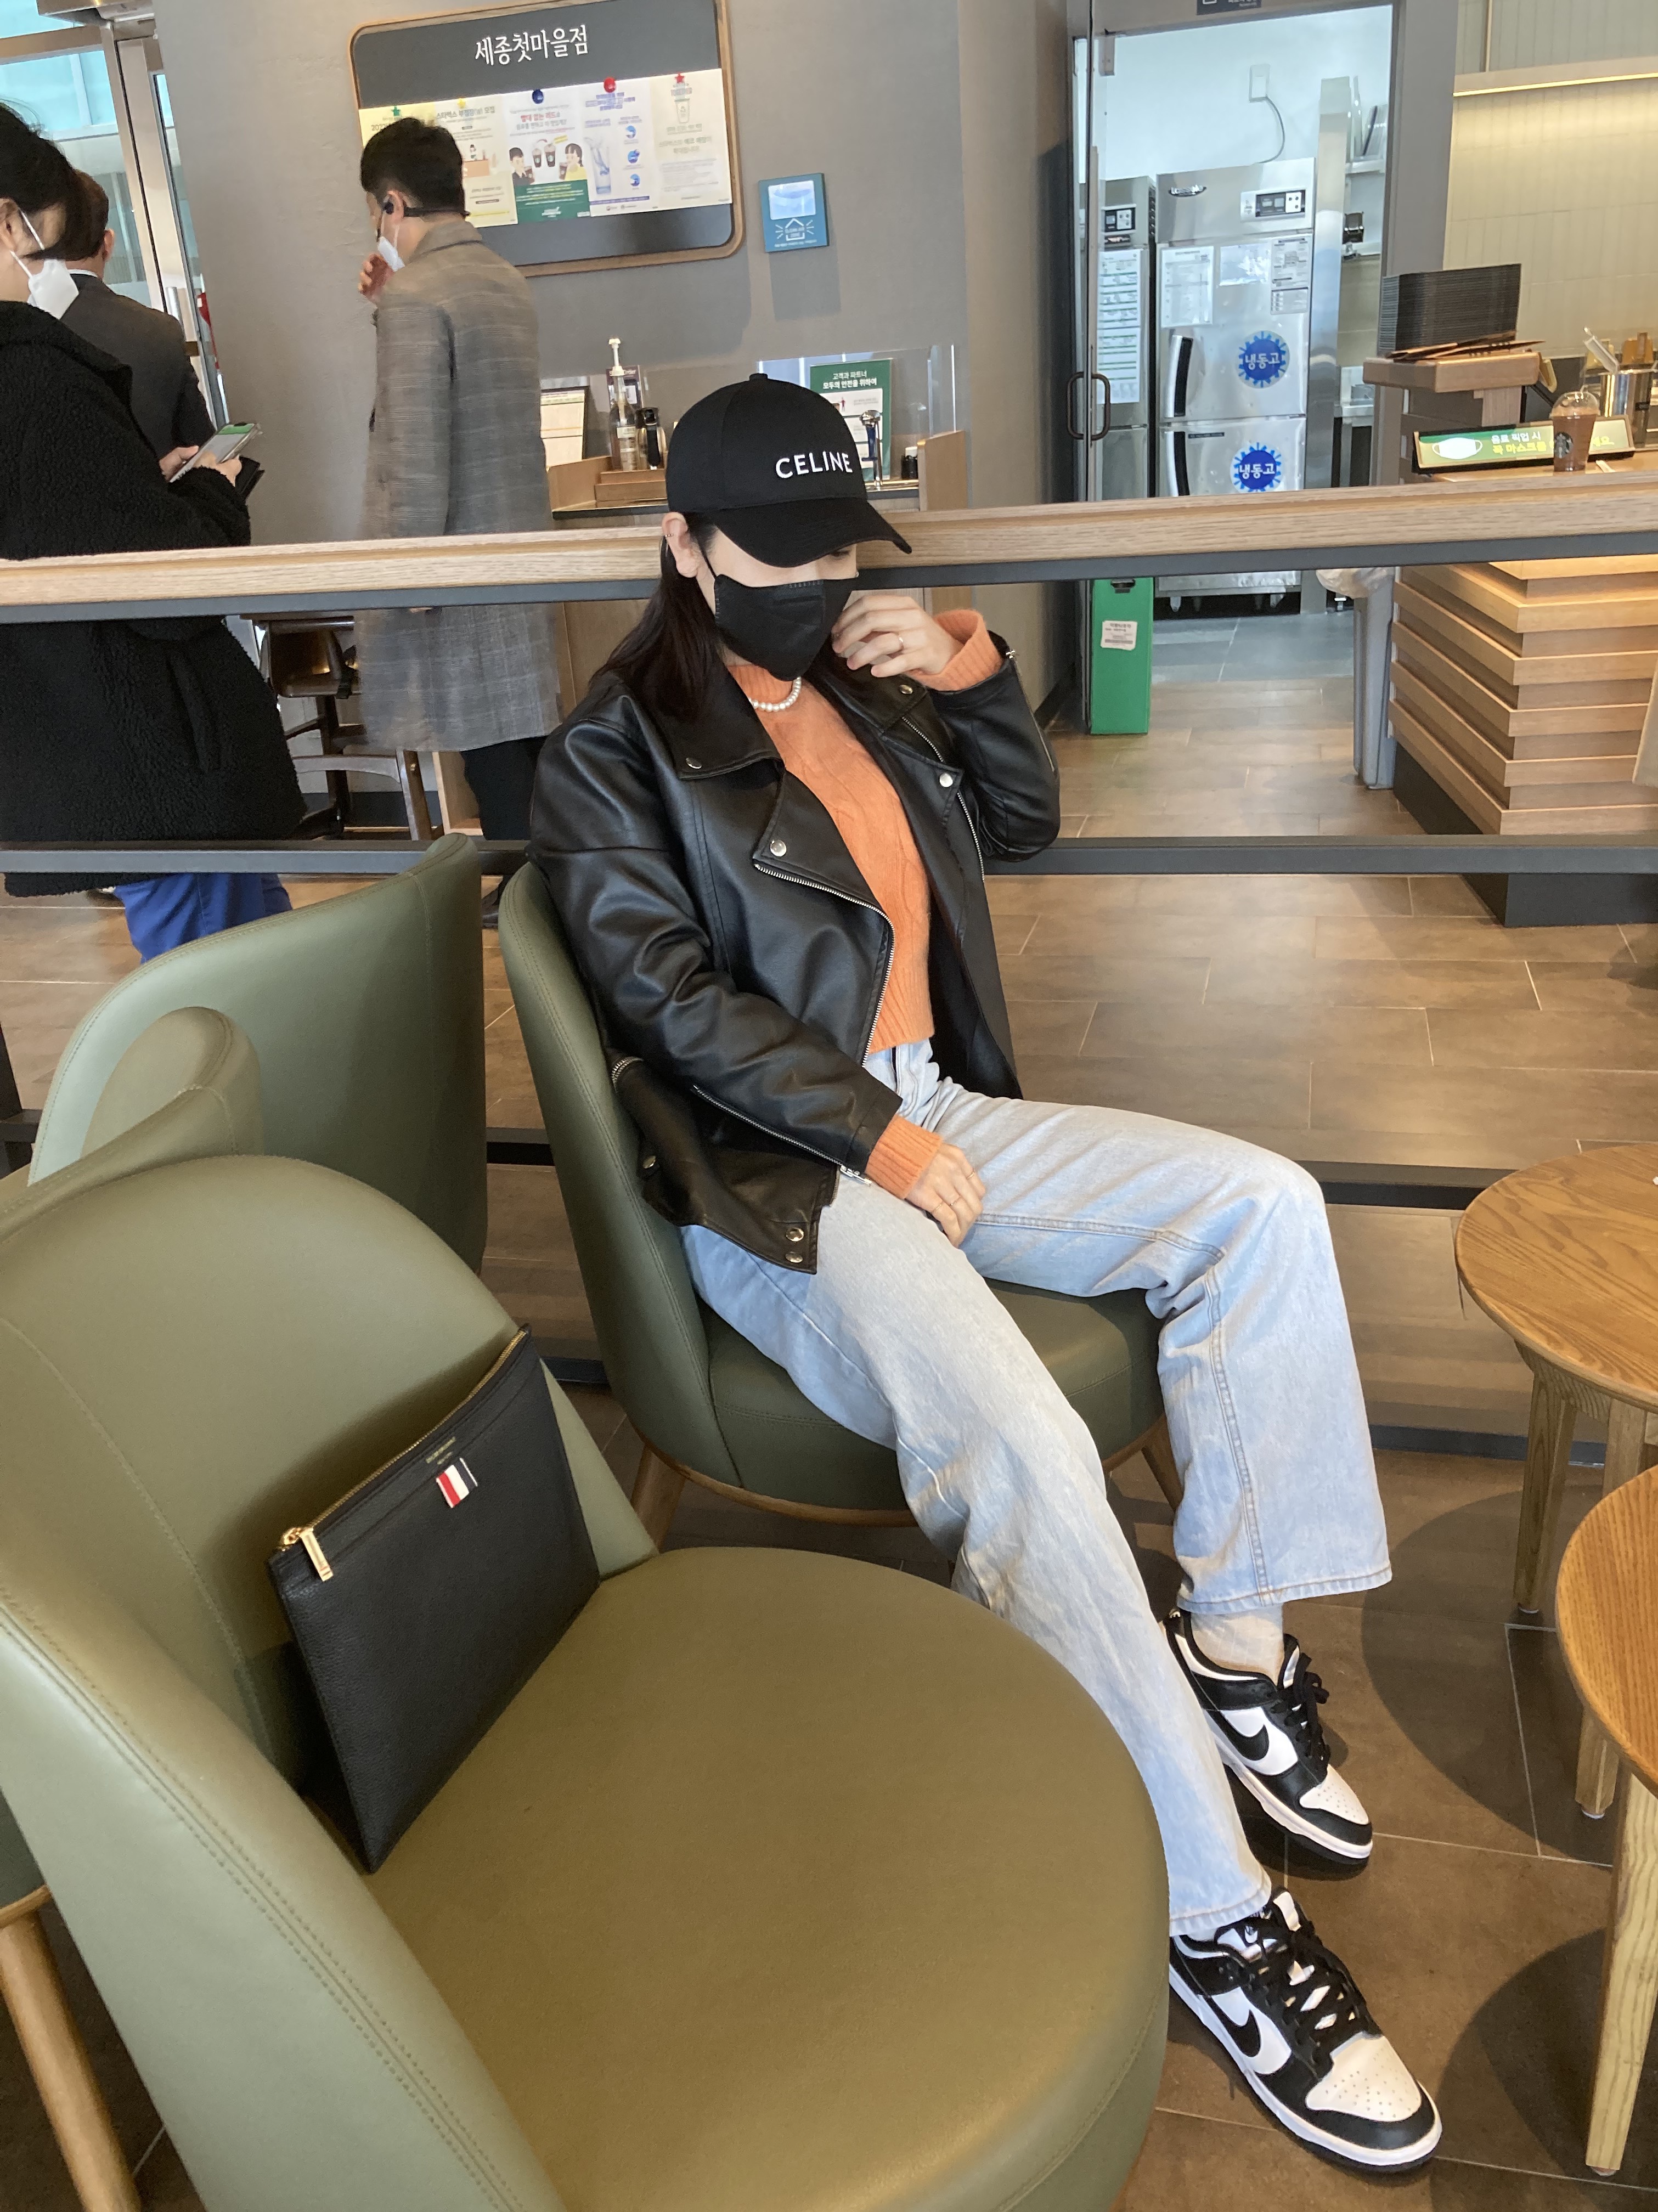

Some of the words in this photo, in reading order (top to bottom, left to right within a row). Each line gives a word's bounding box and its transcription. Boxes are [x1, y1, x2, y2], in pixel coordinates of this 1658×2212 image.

[475, 25, 588, 66] 세종첫마을점
[484, 106, 495, 114] 모집
[1245, 353, 1281, 370] 냉동고
[841, 380, 858, 388] 안전을
[860, 377, 877, 386] 위하여
[1532, 430, 1541, 441] 시
[775, 450, 853, 479] CELINE
[1239, 464, 1276, 479] 냉동고
